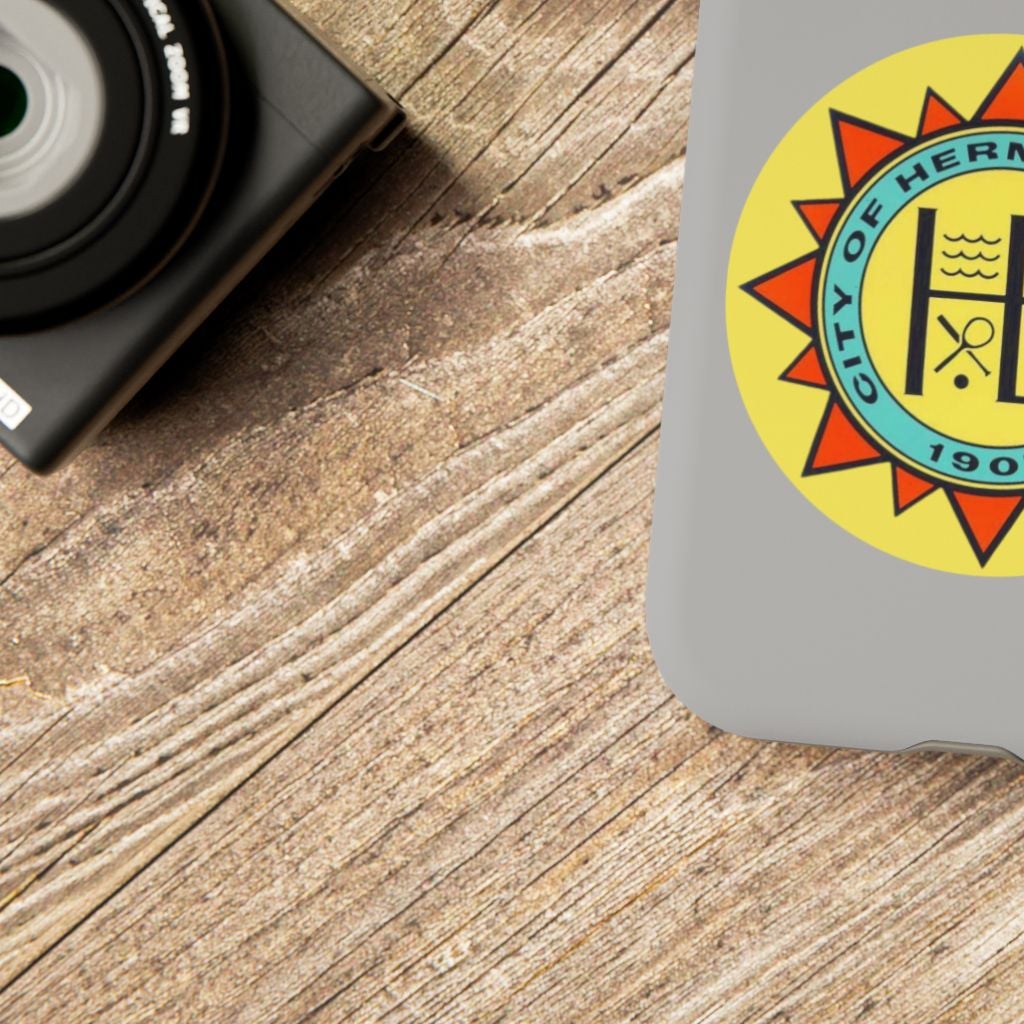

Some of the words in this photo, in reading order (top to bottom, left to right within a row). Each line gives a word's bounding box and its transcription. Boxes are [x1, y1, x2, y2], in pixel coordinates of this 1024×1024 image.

[163, 43, 190, 101] ZOOM
[170, 107, 190, 135] VR
[843, 197, 883, 263] OF
[832, 284, 879, 405] CITY
